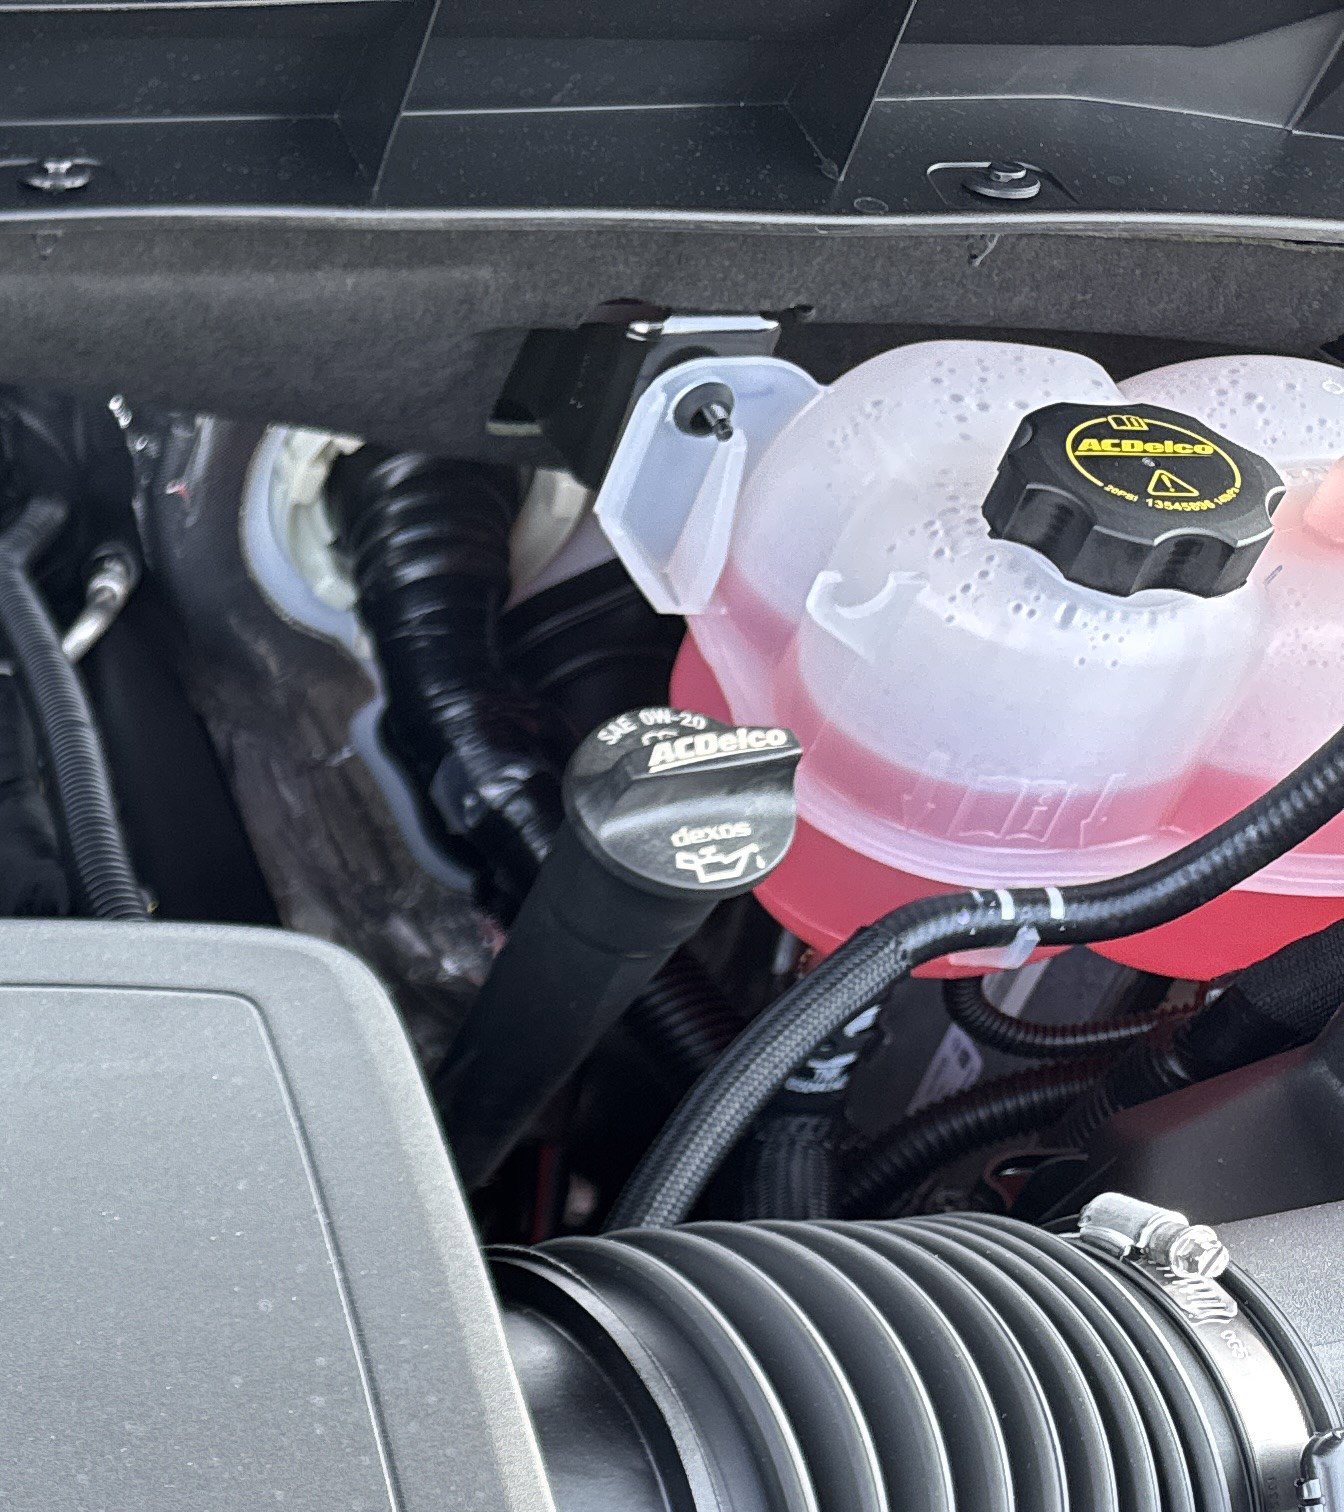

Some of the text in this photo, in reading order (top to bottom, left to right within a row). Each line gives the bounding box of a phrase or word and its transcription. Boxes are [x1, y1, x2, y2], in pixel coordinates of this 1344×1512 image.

[1078, 438, 1214, 455] ACDelco
[597, 709, 707, 746] SAE 0W-20
[648, 728, 789, 767] ACDelco
[671, 822, 752, 847] dexos
